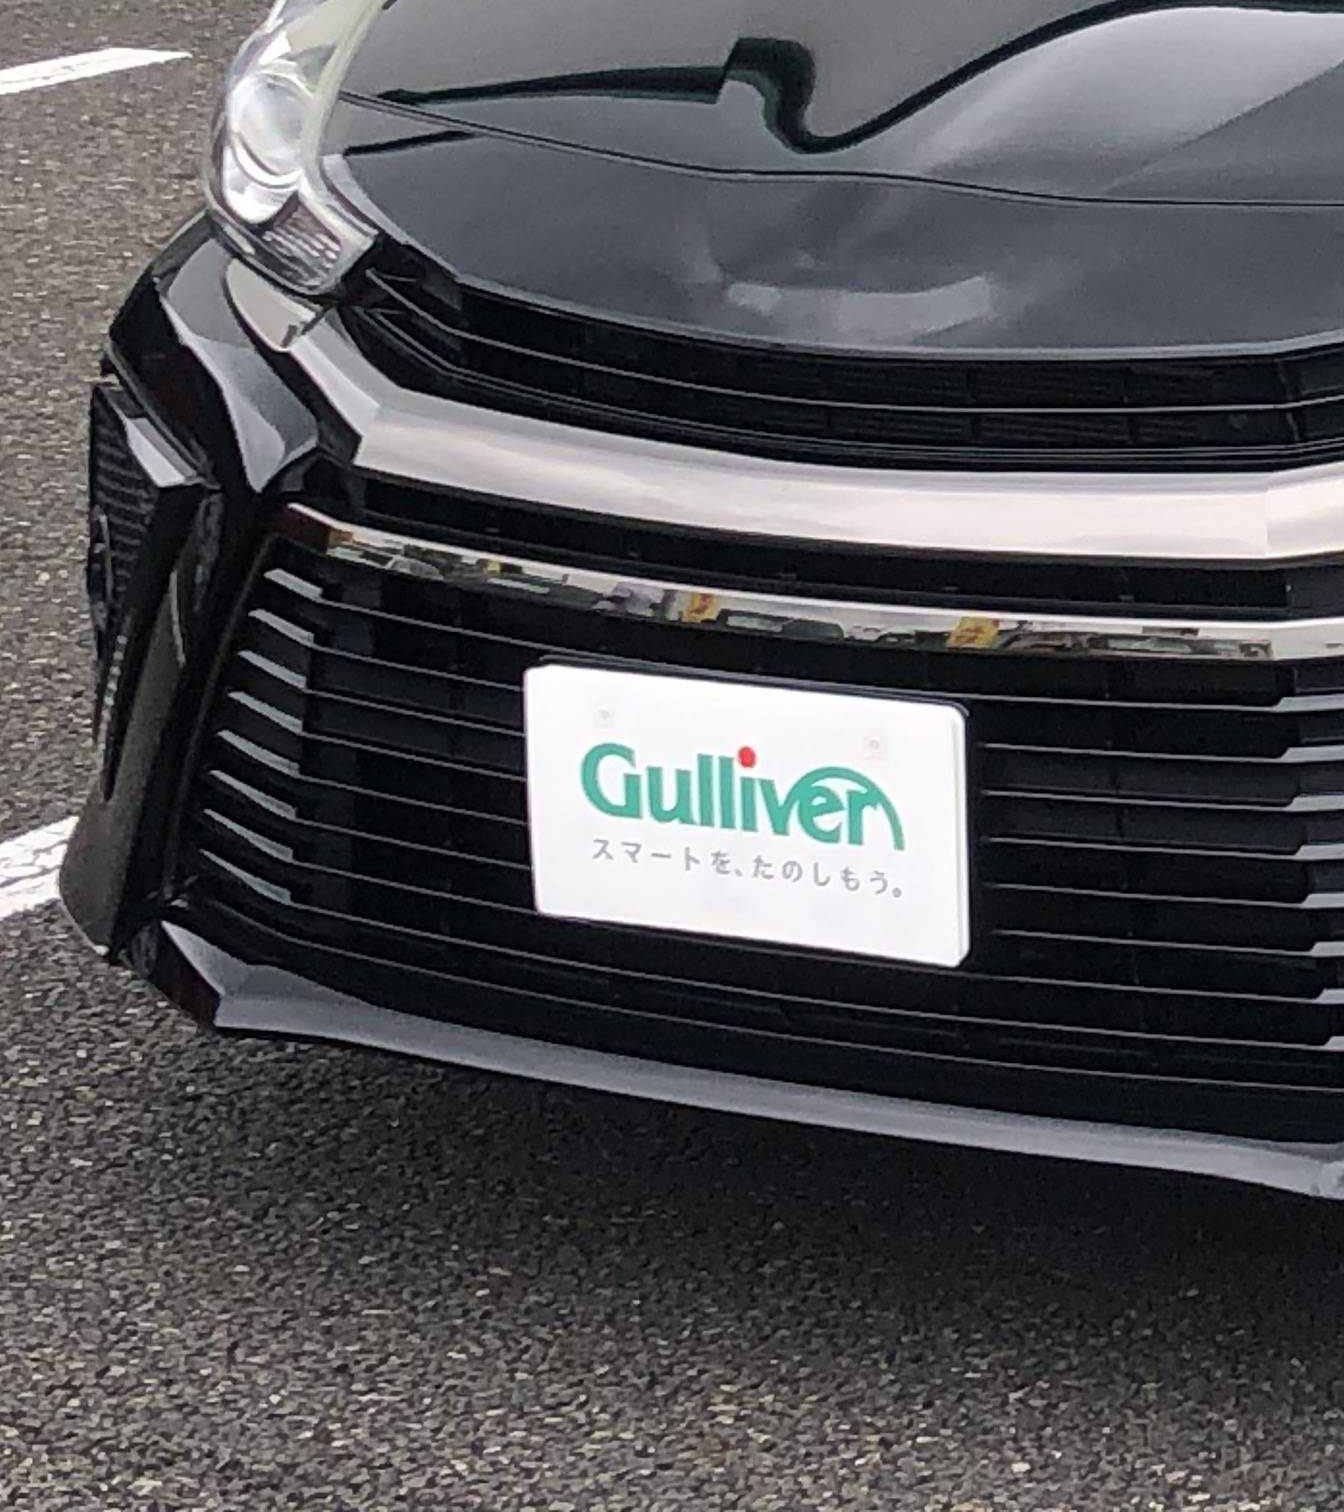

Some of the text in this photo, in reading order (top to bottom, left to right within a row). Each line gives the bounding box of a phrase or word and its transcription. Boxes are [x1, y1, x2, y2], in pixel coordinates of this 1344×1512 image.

[579, 742, 906, 852] Gulliver
[591, 838, 904, 899] スマートを、たのしもう。
